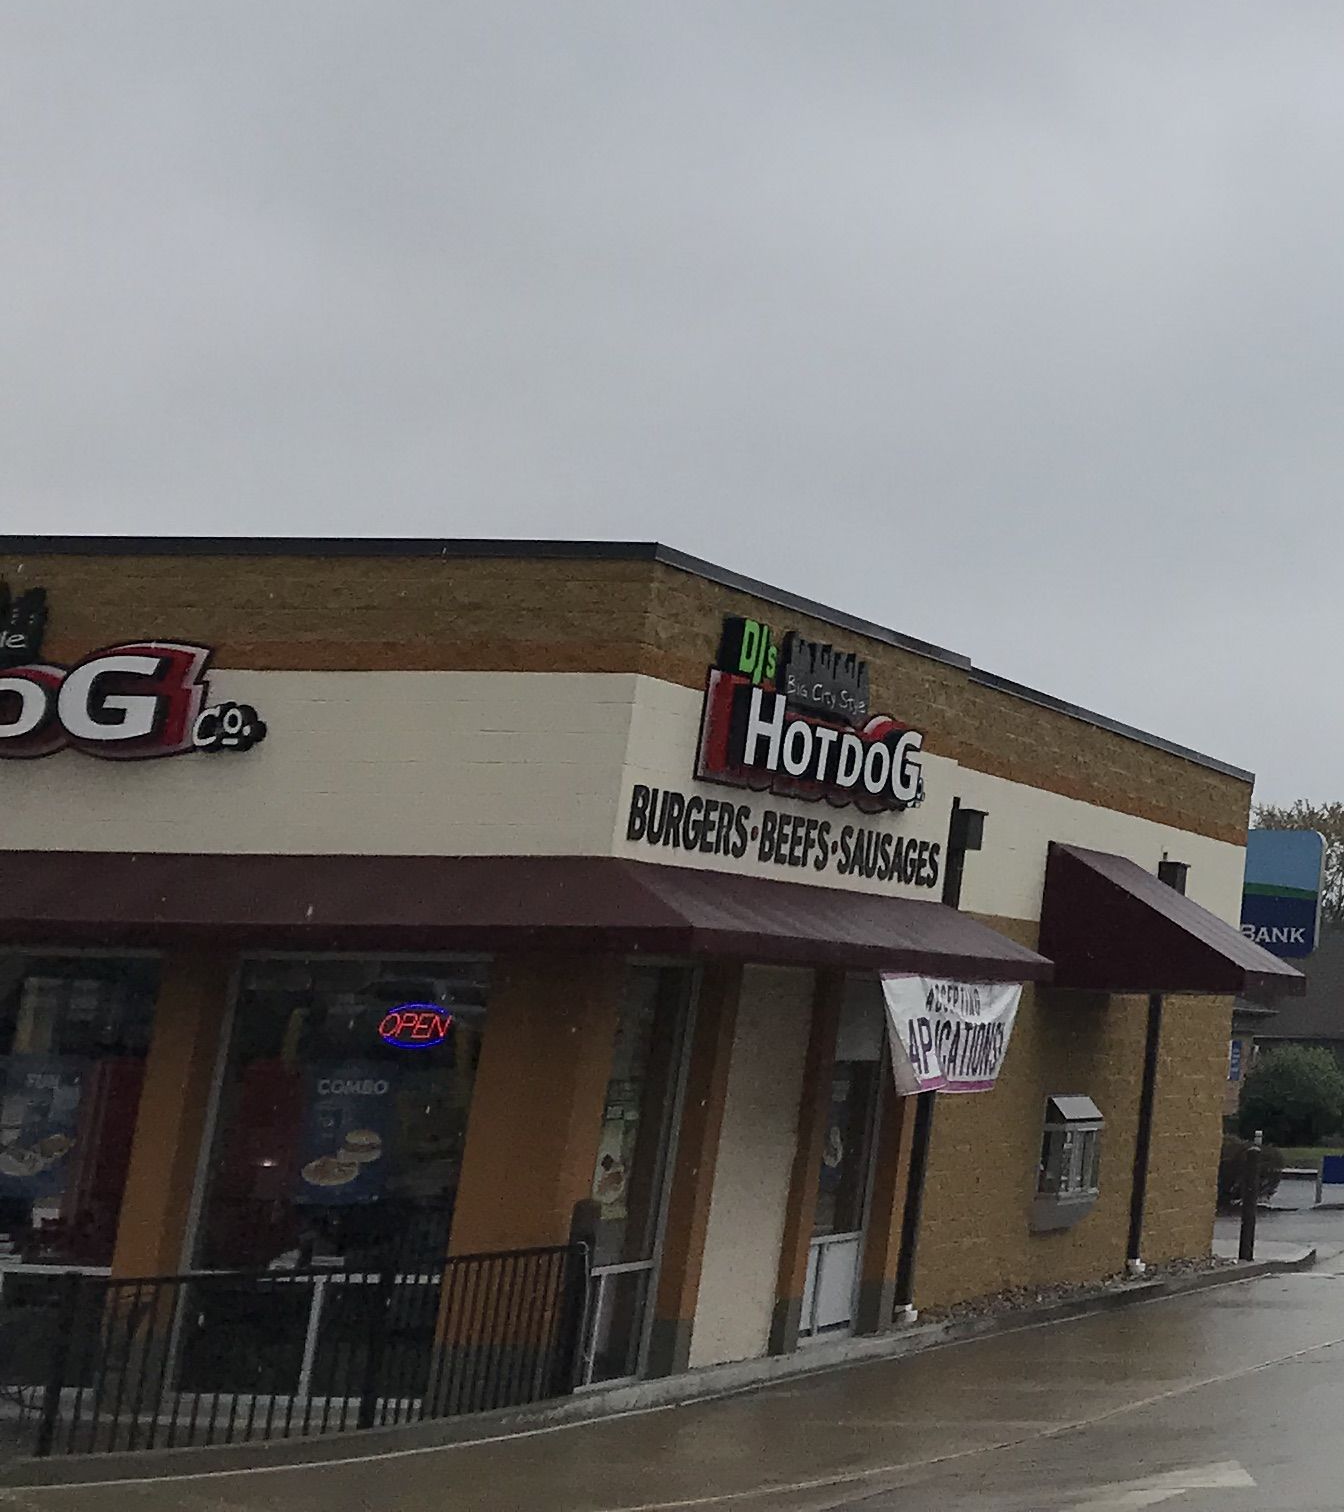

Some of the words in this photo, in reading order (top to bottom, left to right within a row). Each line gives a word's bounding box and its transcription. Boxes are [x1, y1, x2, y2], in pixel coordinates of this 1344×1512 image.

[626, 784, 753, 859] BURGERS
[757, 810, 832, 872] BEEFS
[836, 824, 942, 889] SAUSAGES
[1240, 924, 1307, 943] BANK
[378, 1012, 454, 1039] OPEN
